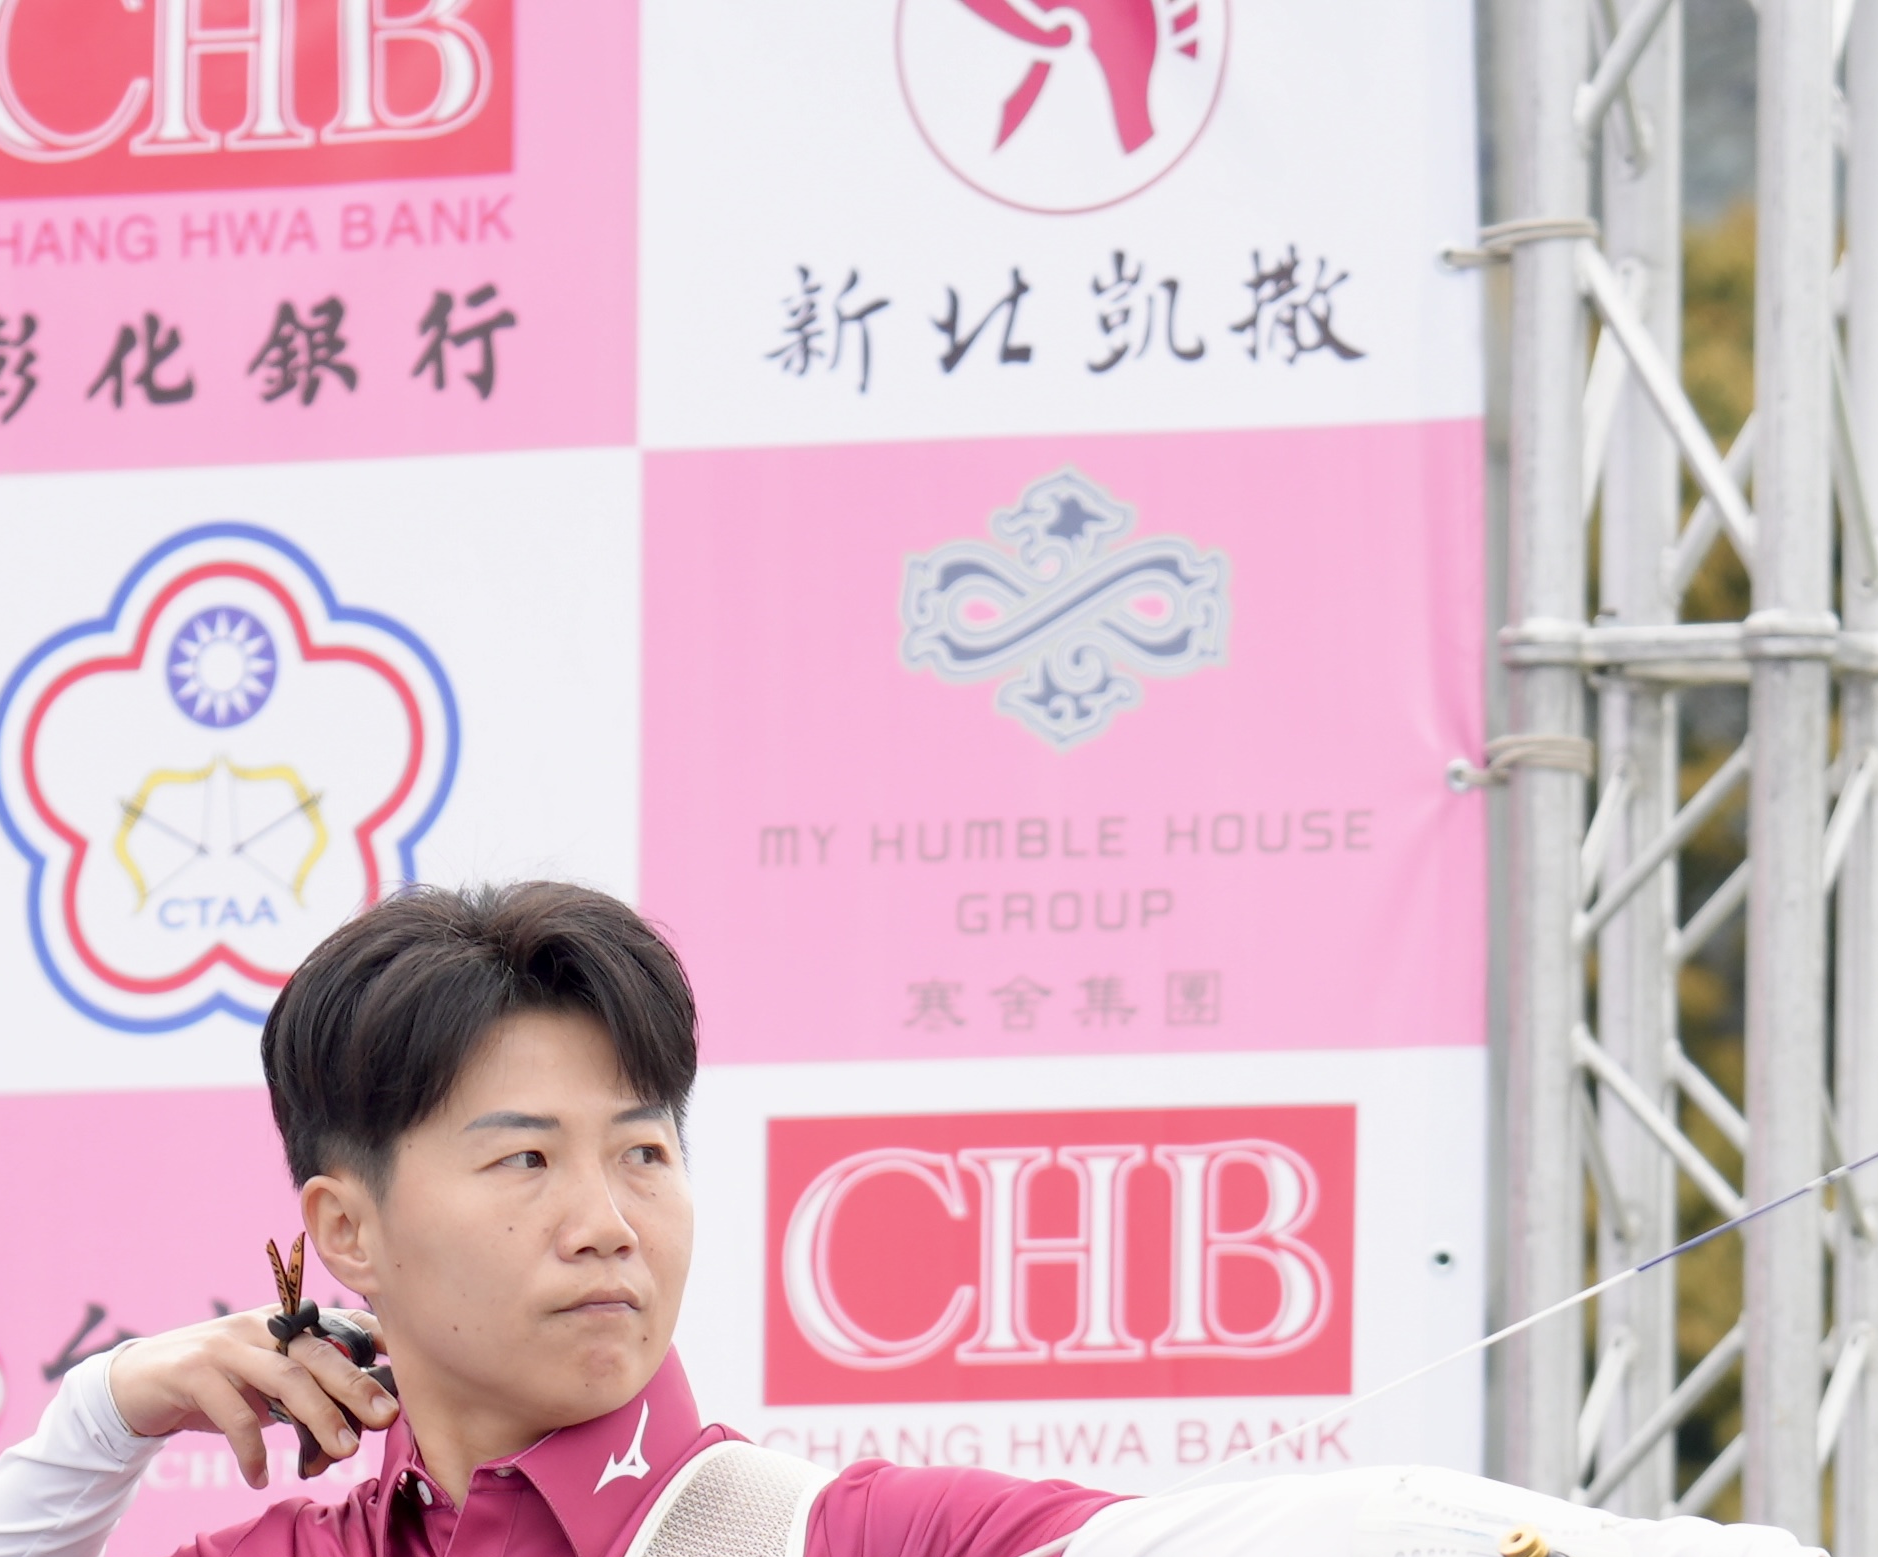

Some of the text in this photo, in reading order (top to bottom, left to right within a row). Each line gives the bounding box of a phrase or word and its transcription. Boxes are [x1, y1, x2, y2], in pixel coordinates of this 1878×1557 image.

[179, 208, 318, 260] HWA
[341, 196, 515, 252] BANK
[765, 242, 1367, 394] 新北凱撒
[758, 809, 1377, 870] MY HUMBLE HOUSE
[158, 896, 278, 931] CTAA
[956, 888, 1176, 936] GROUP
[903, 970, 1222, 1032] 寒舍集團
[782, 1139, 1332, 1371] CHB
[763, 1416, 1353, 1467] CHANG HWA BANK
